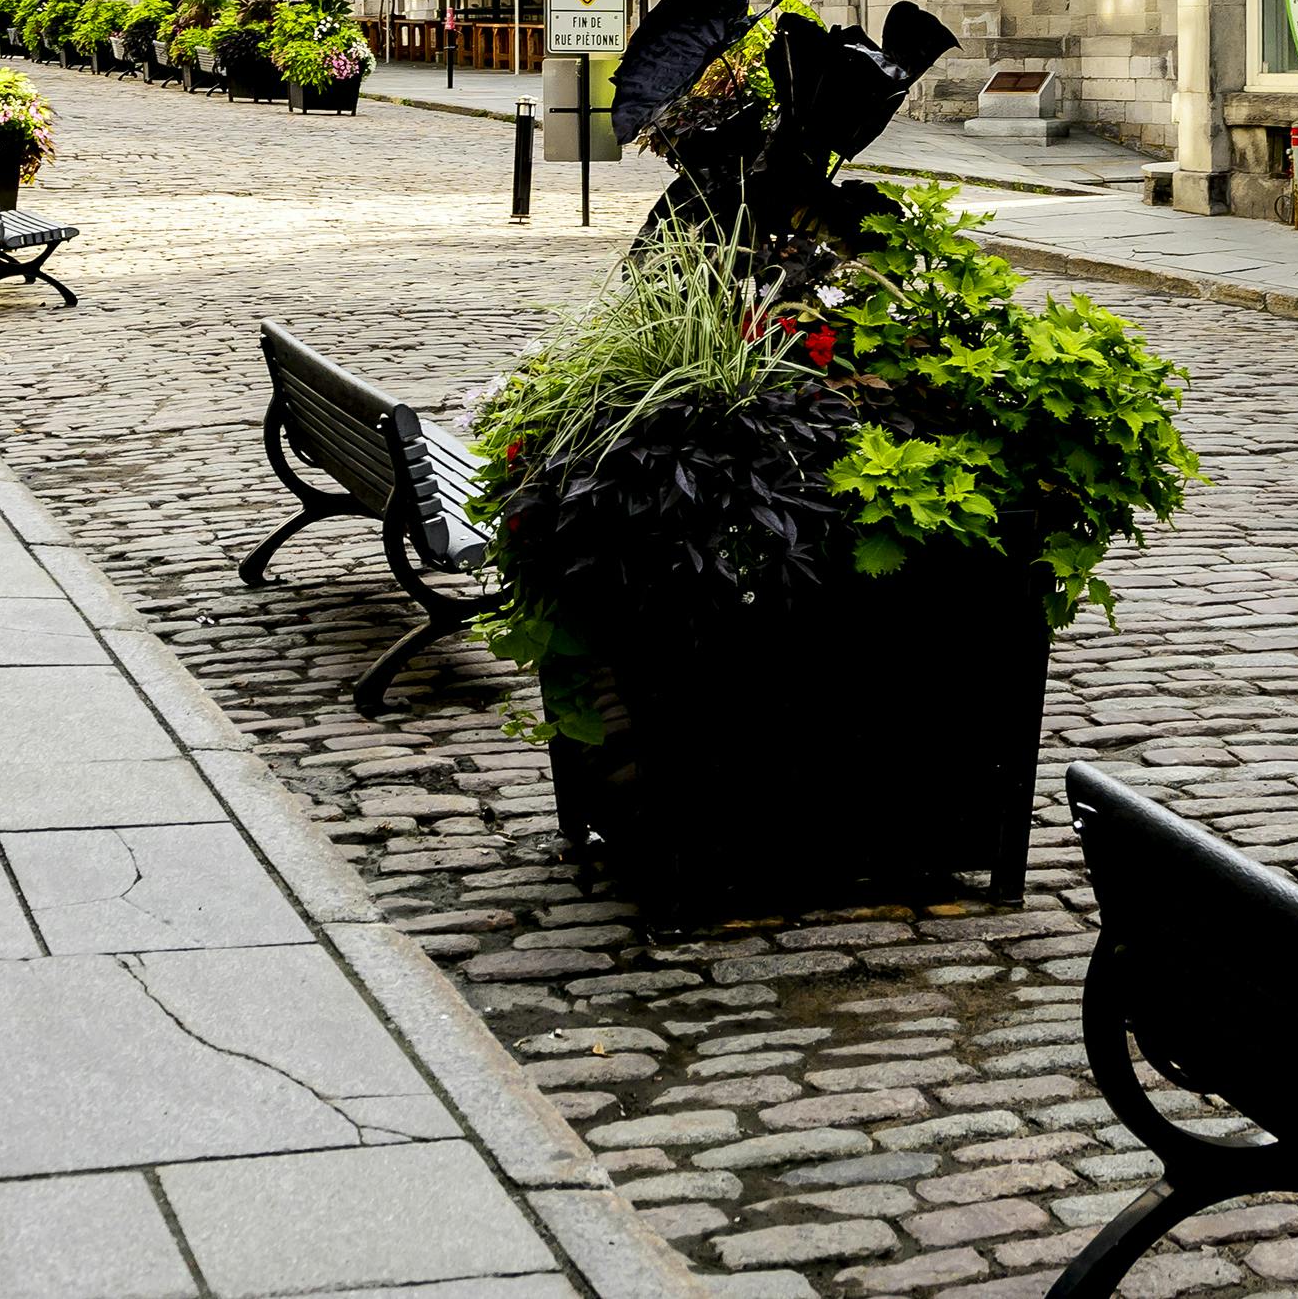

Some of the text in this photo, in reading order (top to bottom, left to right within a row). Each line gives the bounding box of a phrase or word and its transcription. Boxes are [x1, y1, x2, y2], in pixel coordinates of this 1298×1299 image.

[573, 16, 602, 28] FIN DE
[554, 34, 572, 46] RUE
